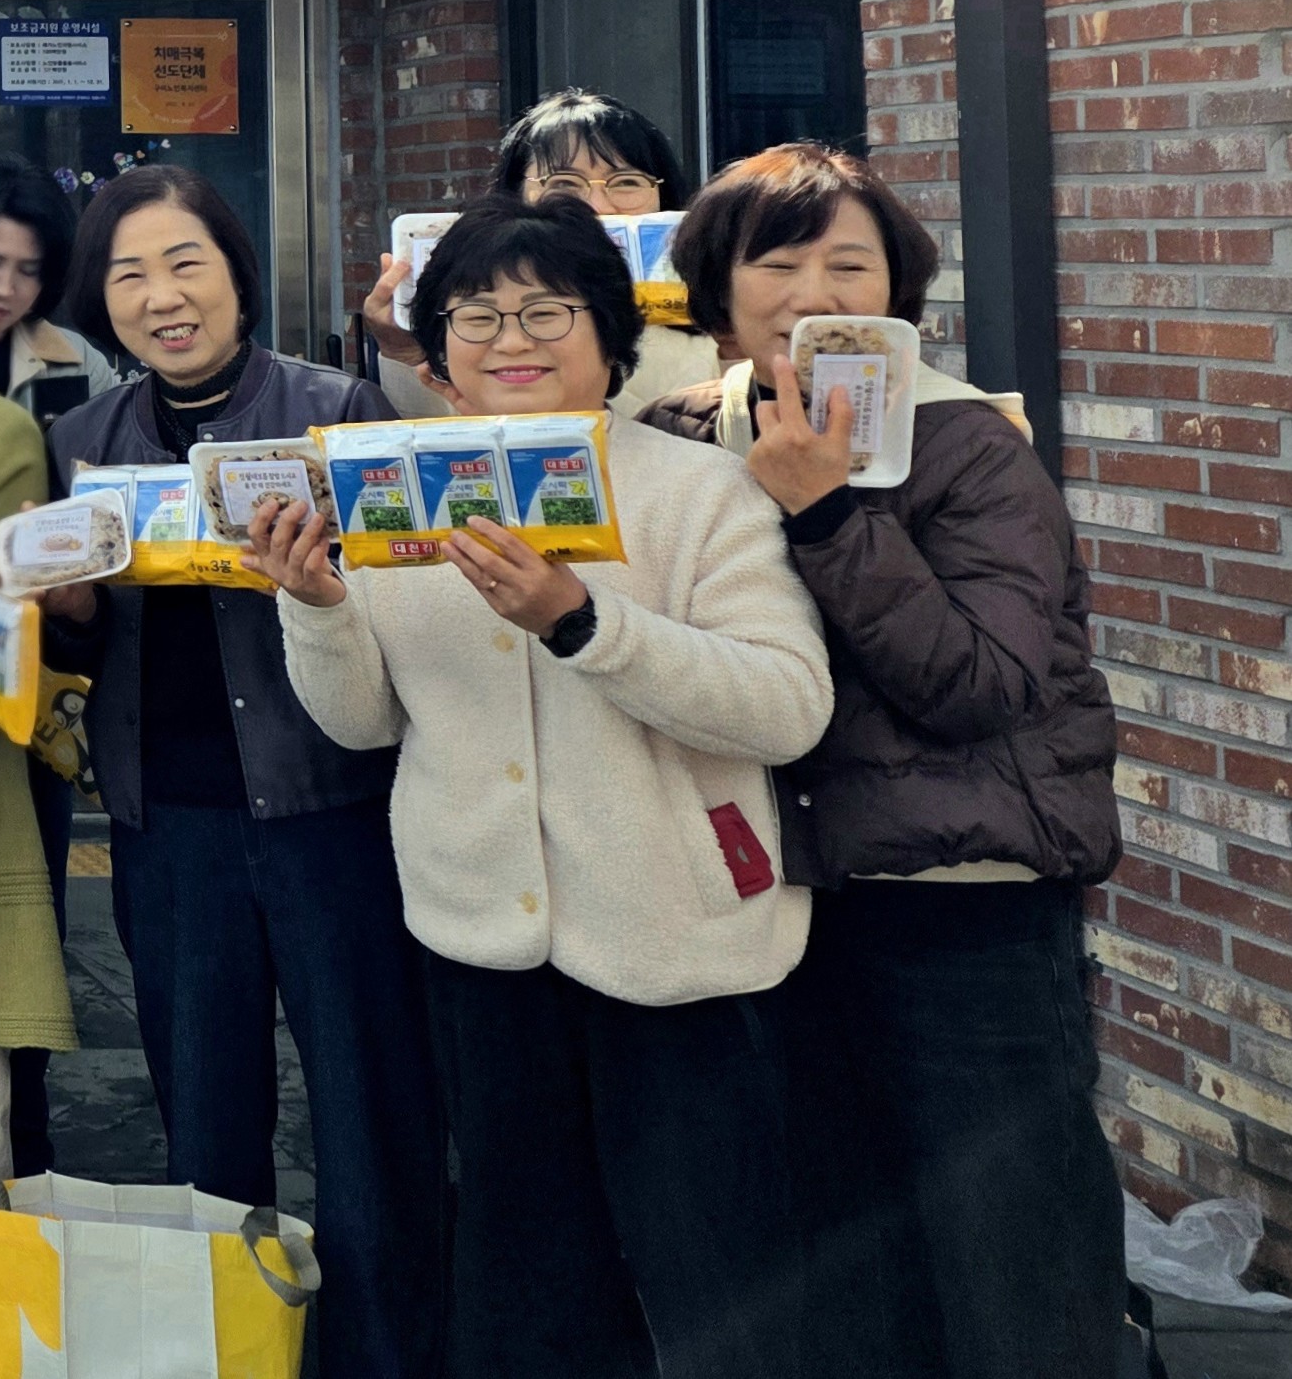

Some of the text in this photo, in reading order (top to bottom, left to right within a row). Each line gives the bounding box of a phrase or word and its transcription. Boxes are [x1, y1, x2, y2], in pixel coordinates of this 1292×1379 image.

[10, 22, 100, 34] 보조금지원 운영시설
[154, 46, 205, 61] 치매극복
[154, 65, 206, 78] 선도단체
[453, 463, 486, 473] 대천김
[547, 459, 581, 469] 대천김
[365, 471, 399, 480] 대천김
[394, 543, 434, 554] 대천김
